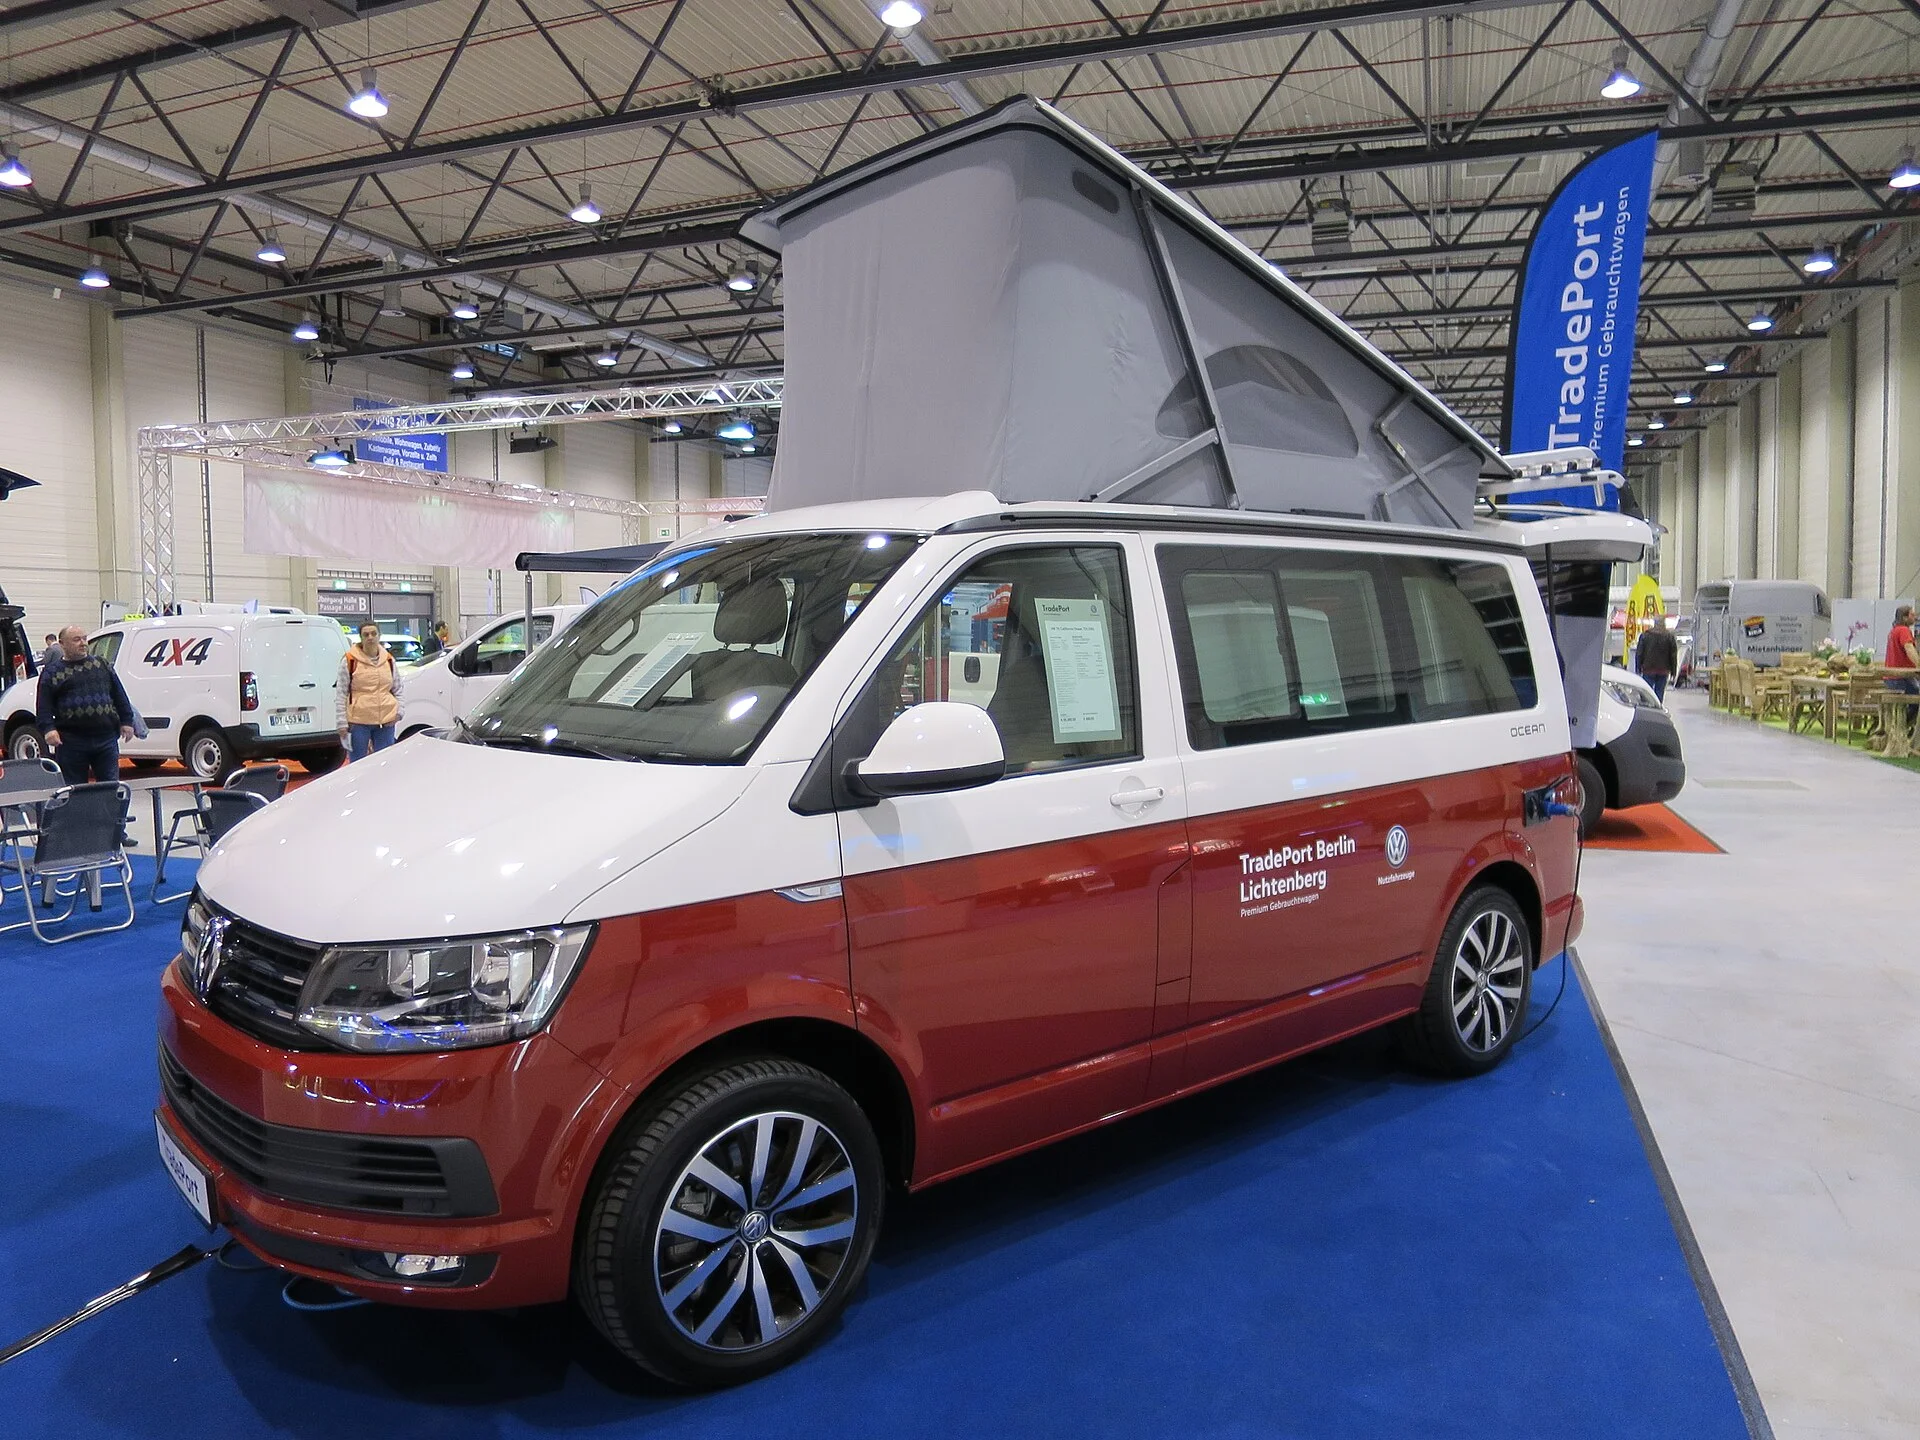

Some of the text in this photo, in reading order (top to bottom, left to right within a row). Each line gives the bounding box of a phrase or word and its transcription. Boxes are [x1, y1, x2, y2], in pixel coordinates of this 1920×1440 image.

[1548, 201, 1604, 450] TradePort
[1589, 186, 1631, 450] Premium Gebrauchtwagen
[320, 604, 341, 613] Passage
[359, 597, 367, 611] B
[1042, 604, 1070, 613] TradePort
[1510, 723, 1546, 737] OCEAN
[1239, 834, 1356, 875] TradePort Berlin
[1240, 868, 1327, 902] Lichtenberg
[1377, 869, 1415, 886] Nutzfahrzeuge
[1240, 892, 1320, 918] Premium Gebrauchtwagen
